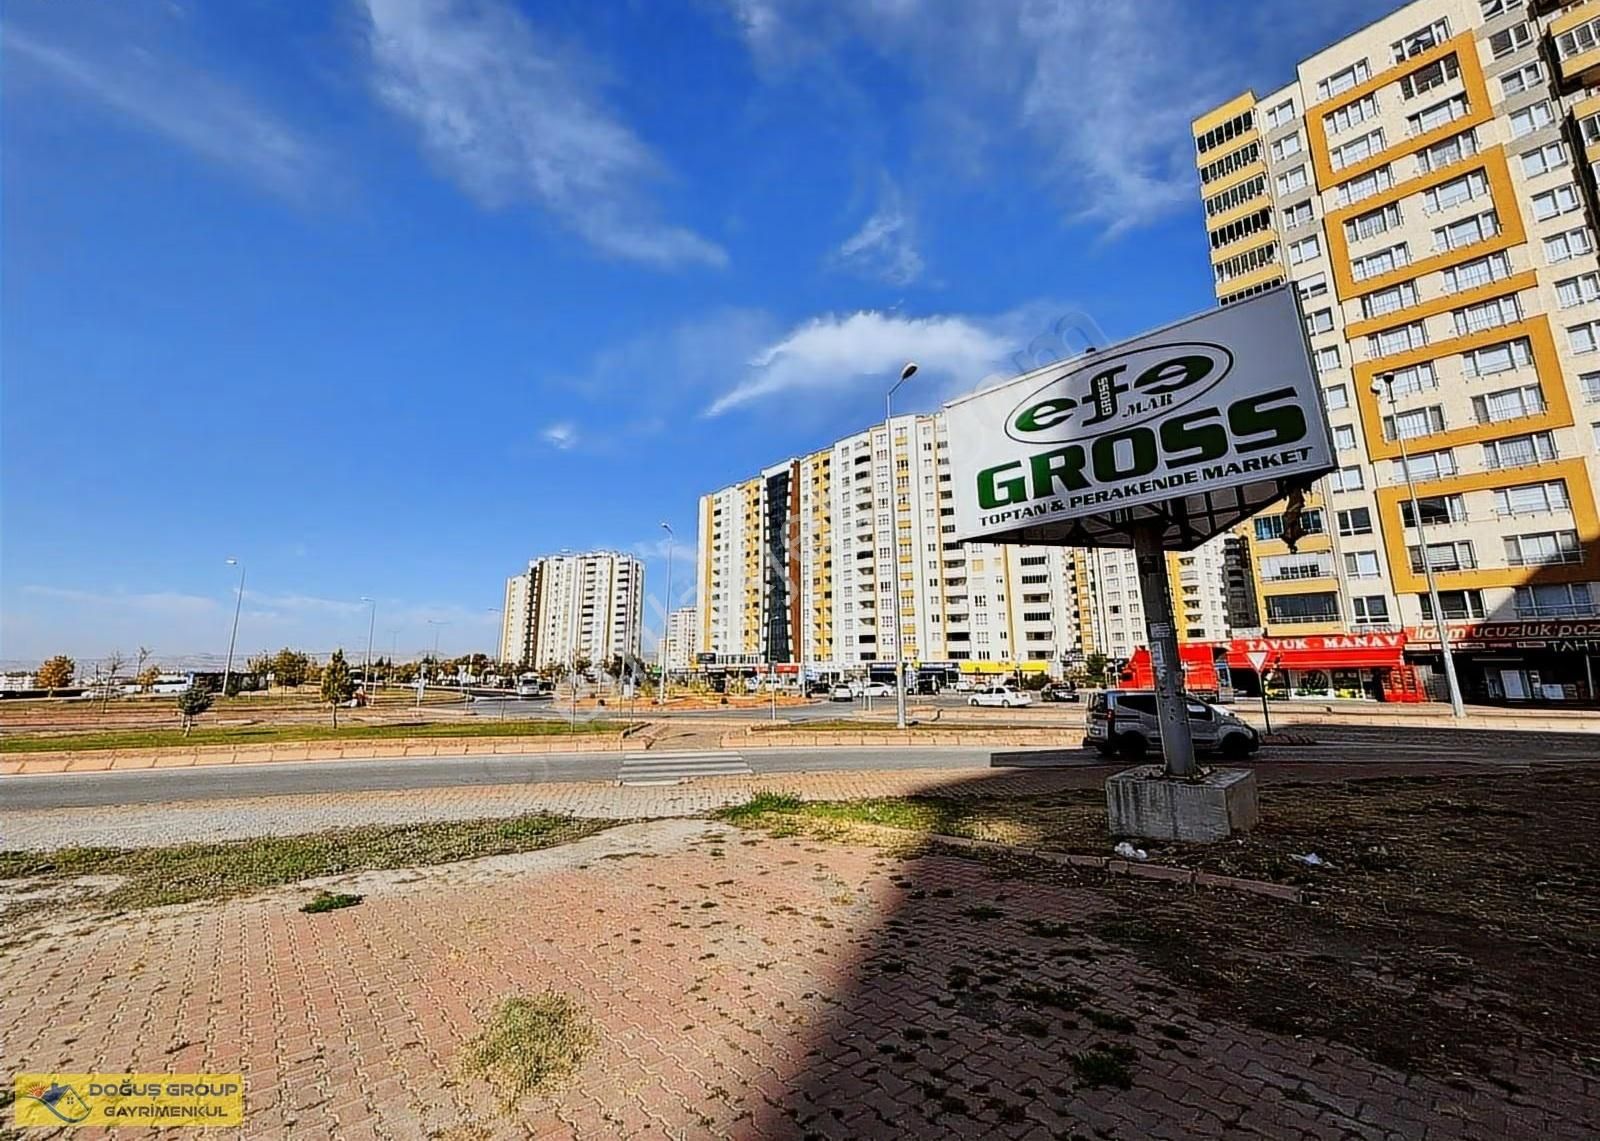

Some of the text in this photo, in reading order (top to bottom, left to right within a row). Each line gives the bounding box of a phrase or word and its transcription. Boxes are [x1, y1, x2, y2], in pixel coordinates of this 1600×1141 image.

[1101, 376, 1112, 417] GROSS
[977, 387, 1306, 510] GROSS
[979, 446, 1313, 527] TOPTAN & PERAKENDE MARKET
[1245, 638, 1308, 650] TAVUK
[1324, 635, 1399, 649] MANAV
[1472, 623, 1550, 638] ucuzluk
